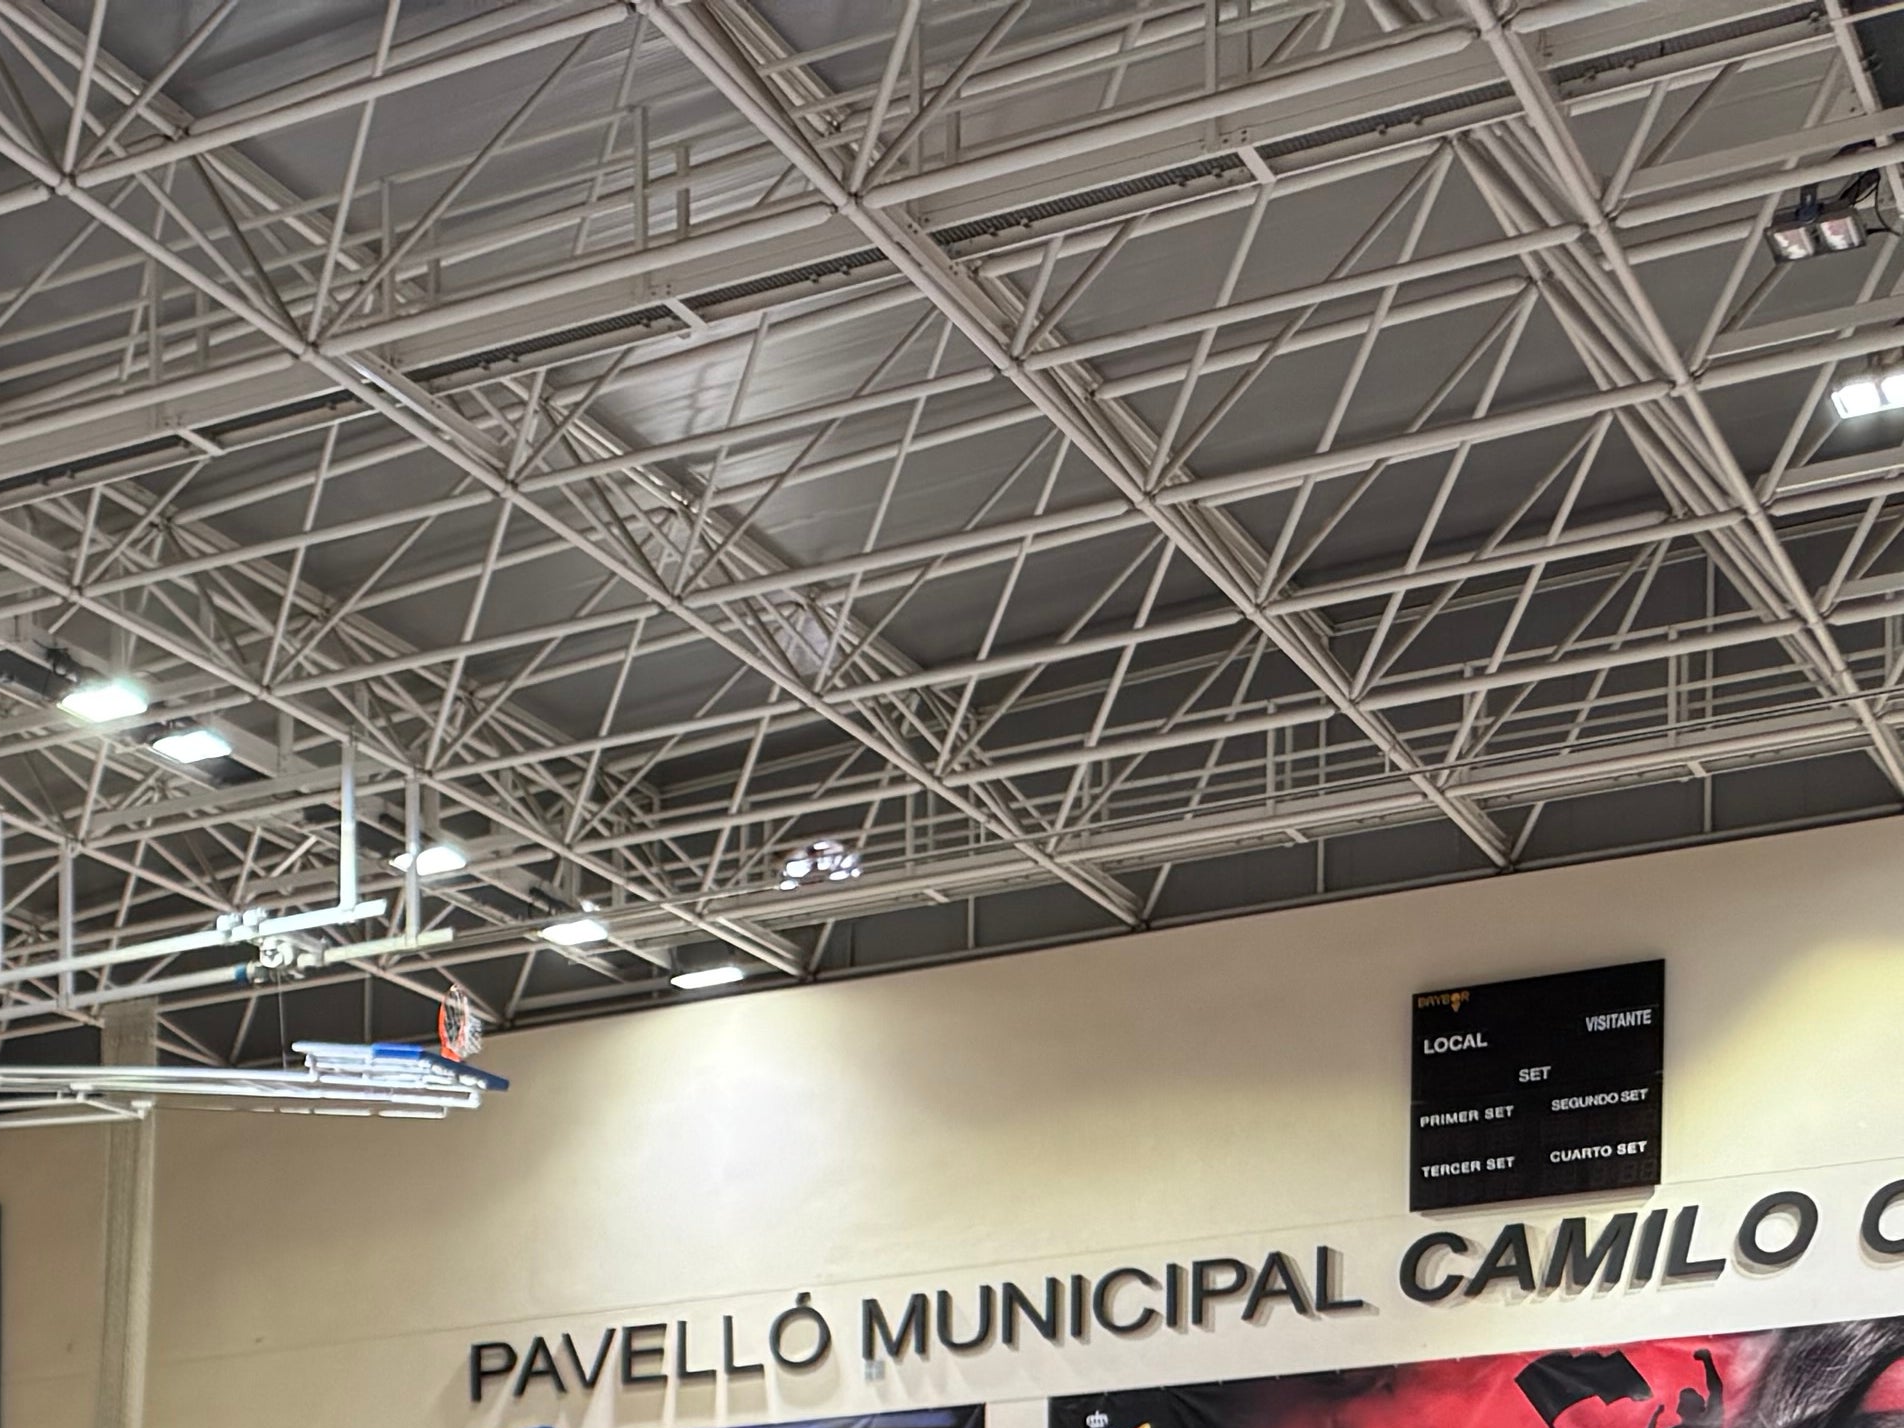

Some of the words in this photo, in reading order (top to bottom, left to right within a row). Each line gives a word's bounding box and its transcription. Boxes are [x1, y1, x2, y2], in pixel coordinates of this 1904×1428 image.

[1585, 1009, 1652, 1032] VISITANTE
[1423, 1033, 1488, 1054] LOCAL
[1518, 1066, 1551, 1083] SET
[1551, 1092, 1619, 1112] SEGUNDO
[1620, 1088, 1649, 1103] SET
[1420, 1110, 1479, 1128] PRIMER
[1484, 1105, 1514, 1120] SET
[1550, 1145, 1612, 1163] CUARTO
[1616, 1141, 1648, 1156] SET
[1421, 1160, 1481, 1178] TERCER
[1486, 1156, 1515, 1171] SET
[470, 1292, 831, 1401] PAVELLÓ
[862, 1246, 1365, 1361] MUNICIPAL
[1399, 1190, 1819, 1302] CAMILO
